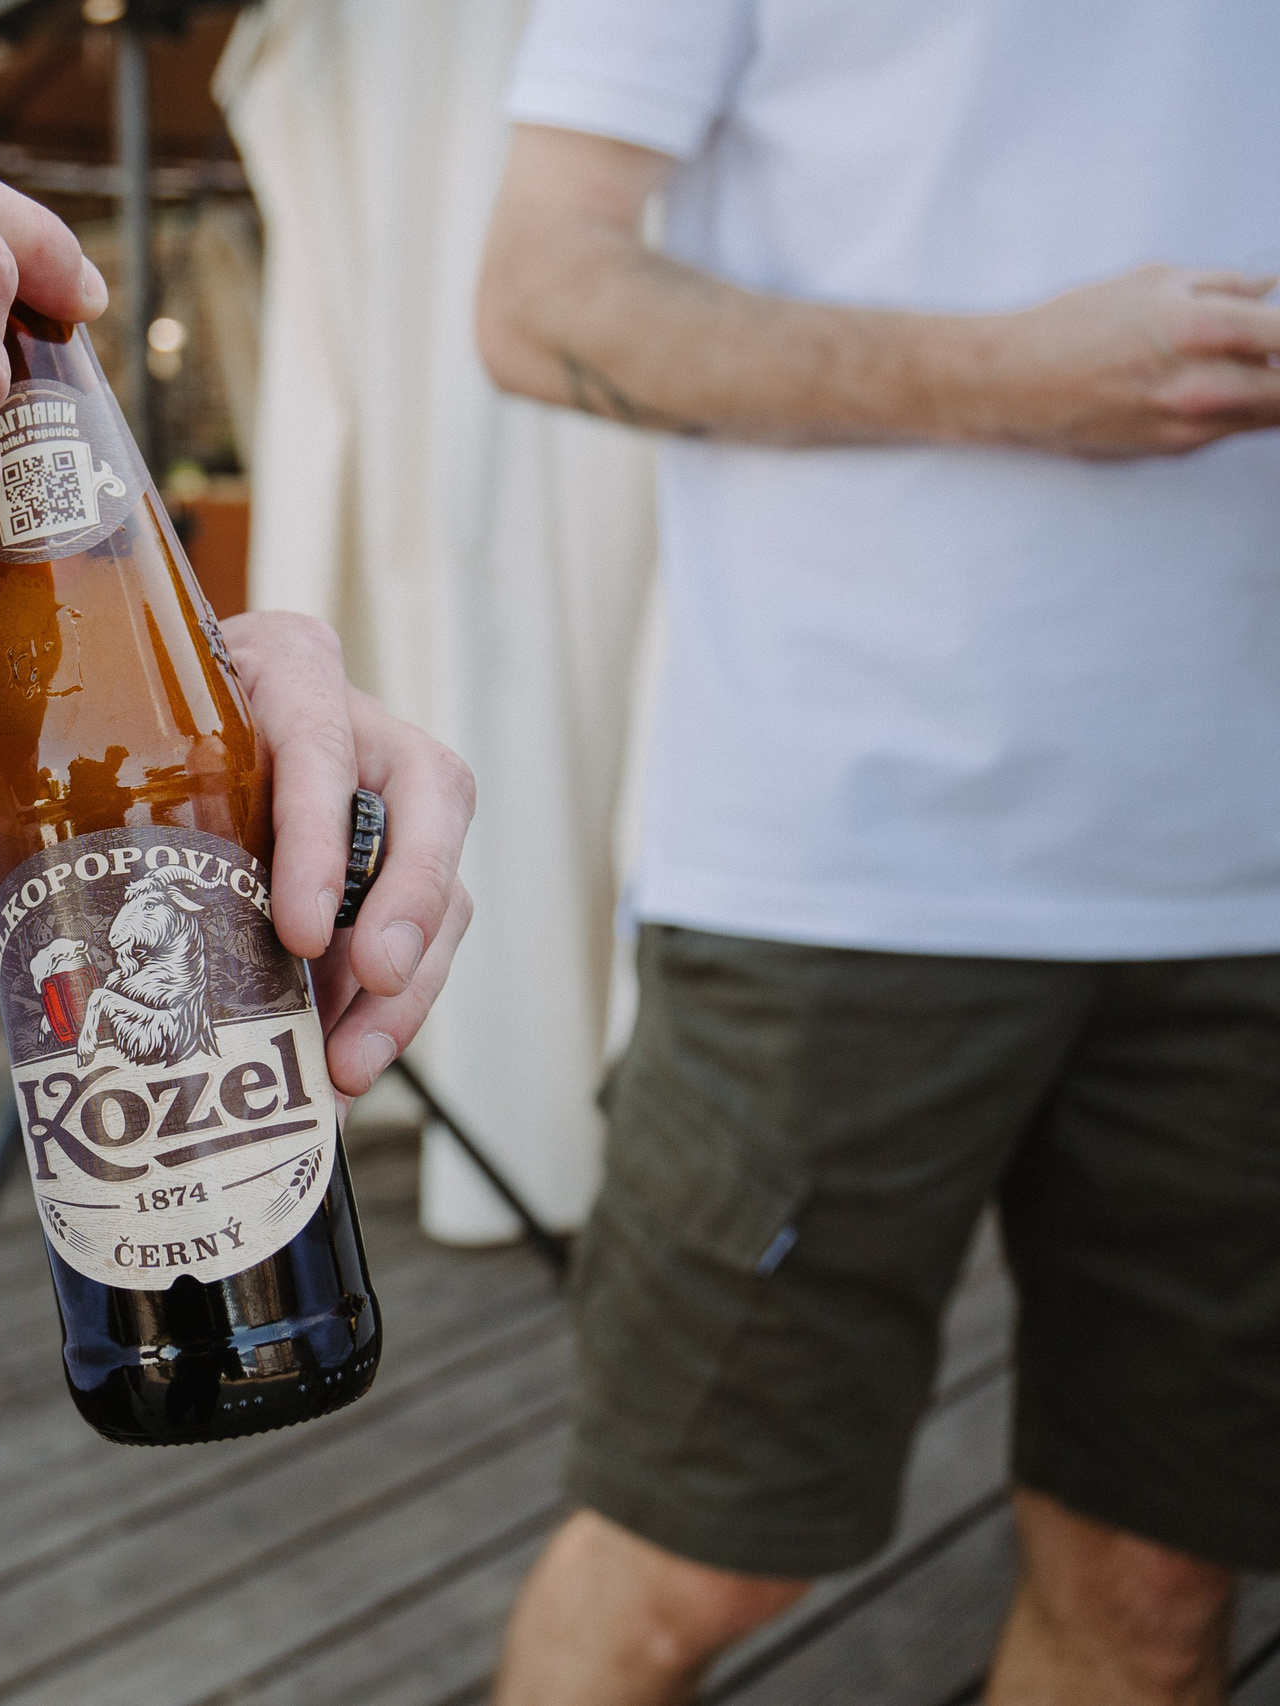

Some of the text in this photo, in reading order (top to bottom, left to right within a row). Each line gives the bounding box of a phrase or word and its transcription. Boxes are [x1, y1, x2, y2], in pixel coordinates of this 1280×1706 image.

[26, 426, 79, 442] Popovice
[19, 1028, 314, 1182] Kozel
[134, 1182, 209, 1213] 1874
[114, 1216, 245, 1268] ČERNÝ
